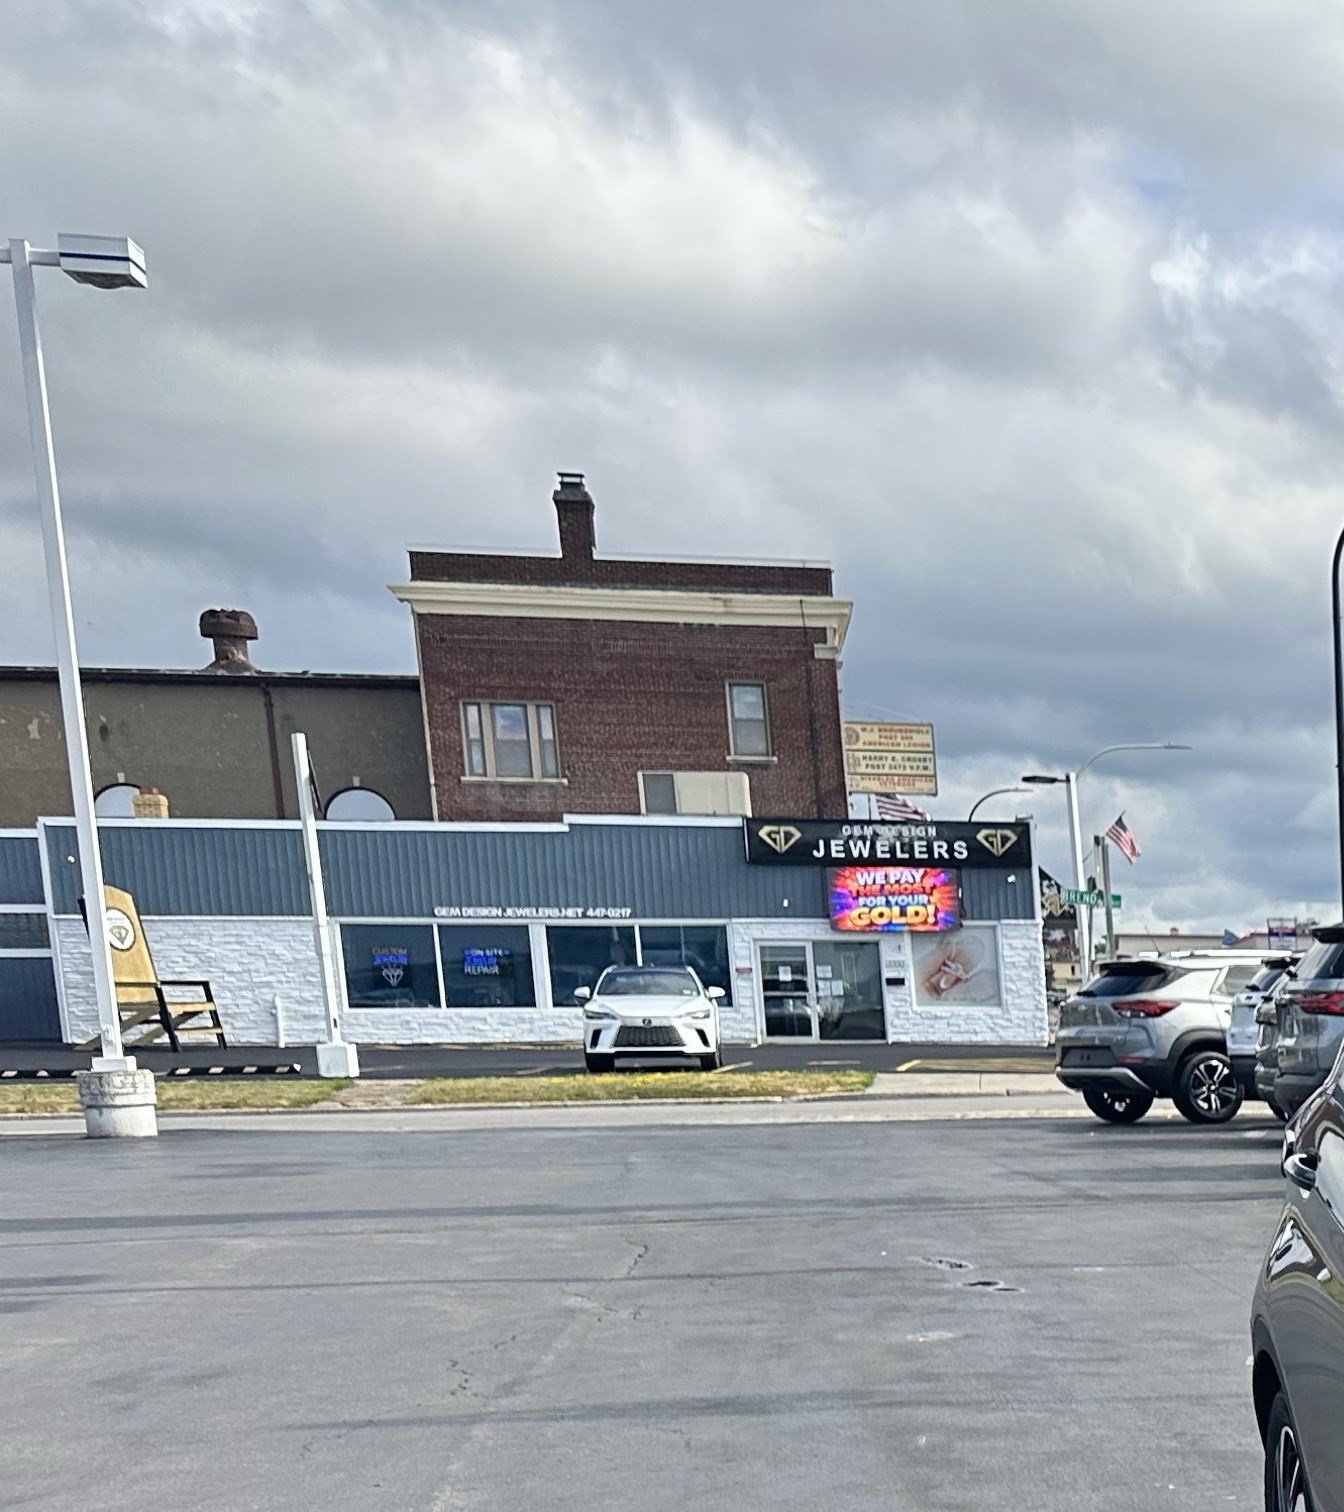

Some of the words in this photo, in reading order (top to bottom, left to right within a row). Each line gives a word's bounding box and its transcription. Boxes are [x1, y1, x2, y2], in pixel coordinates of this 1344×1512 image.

[812, 838, 969, 859] JEWELERS
[856, 870, 886, 885] WE
[888, 869, 925, 884] PAY
[850, 884, 881, 897] THE
[884, 882, 935, 895] MOST
[858, 895, 886, 907] FOR
[887, 894, 929, 906] YOUR
[849, 905, 937, 926] GOLD!
